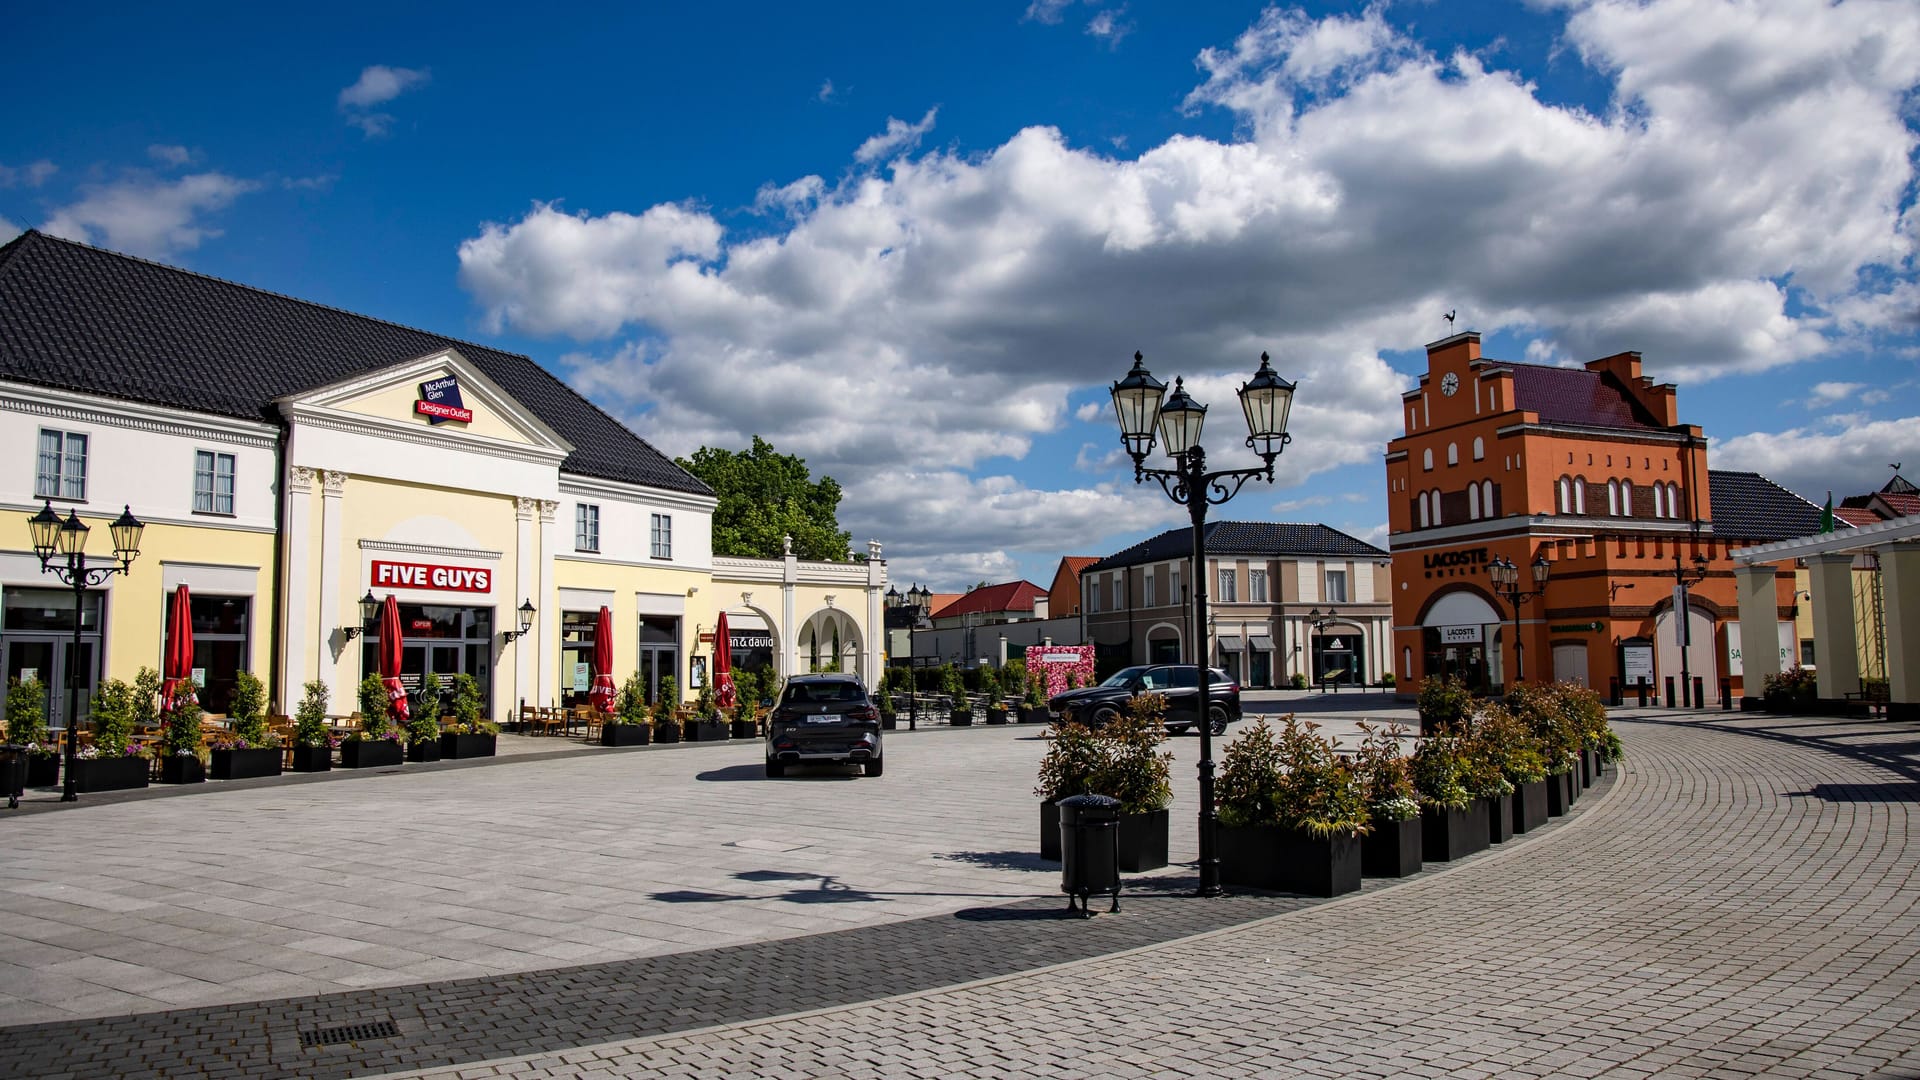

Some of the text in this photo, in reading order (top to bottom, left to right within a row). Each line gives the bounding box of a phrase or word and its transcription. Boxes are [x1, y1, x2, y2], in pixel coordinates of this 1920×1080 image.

[425, 379, 455, 392] McArthur
[427, 390, 444, 400] Glen
[420, 402, 470, 419] Designer Outlet
[1423, 547, 1488, 569] LACOSTE
[378, 564, 488, 589] FIVE GUYS
[1424, 565, 1488, 579] OUTLET
[1447, 628, 1475, 636] LACOSTE
[739, 637, 748, 647] &
[748, 637, 774, 647] david
